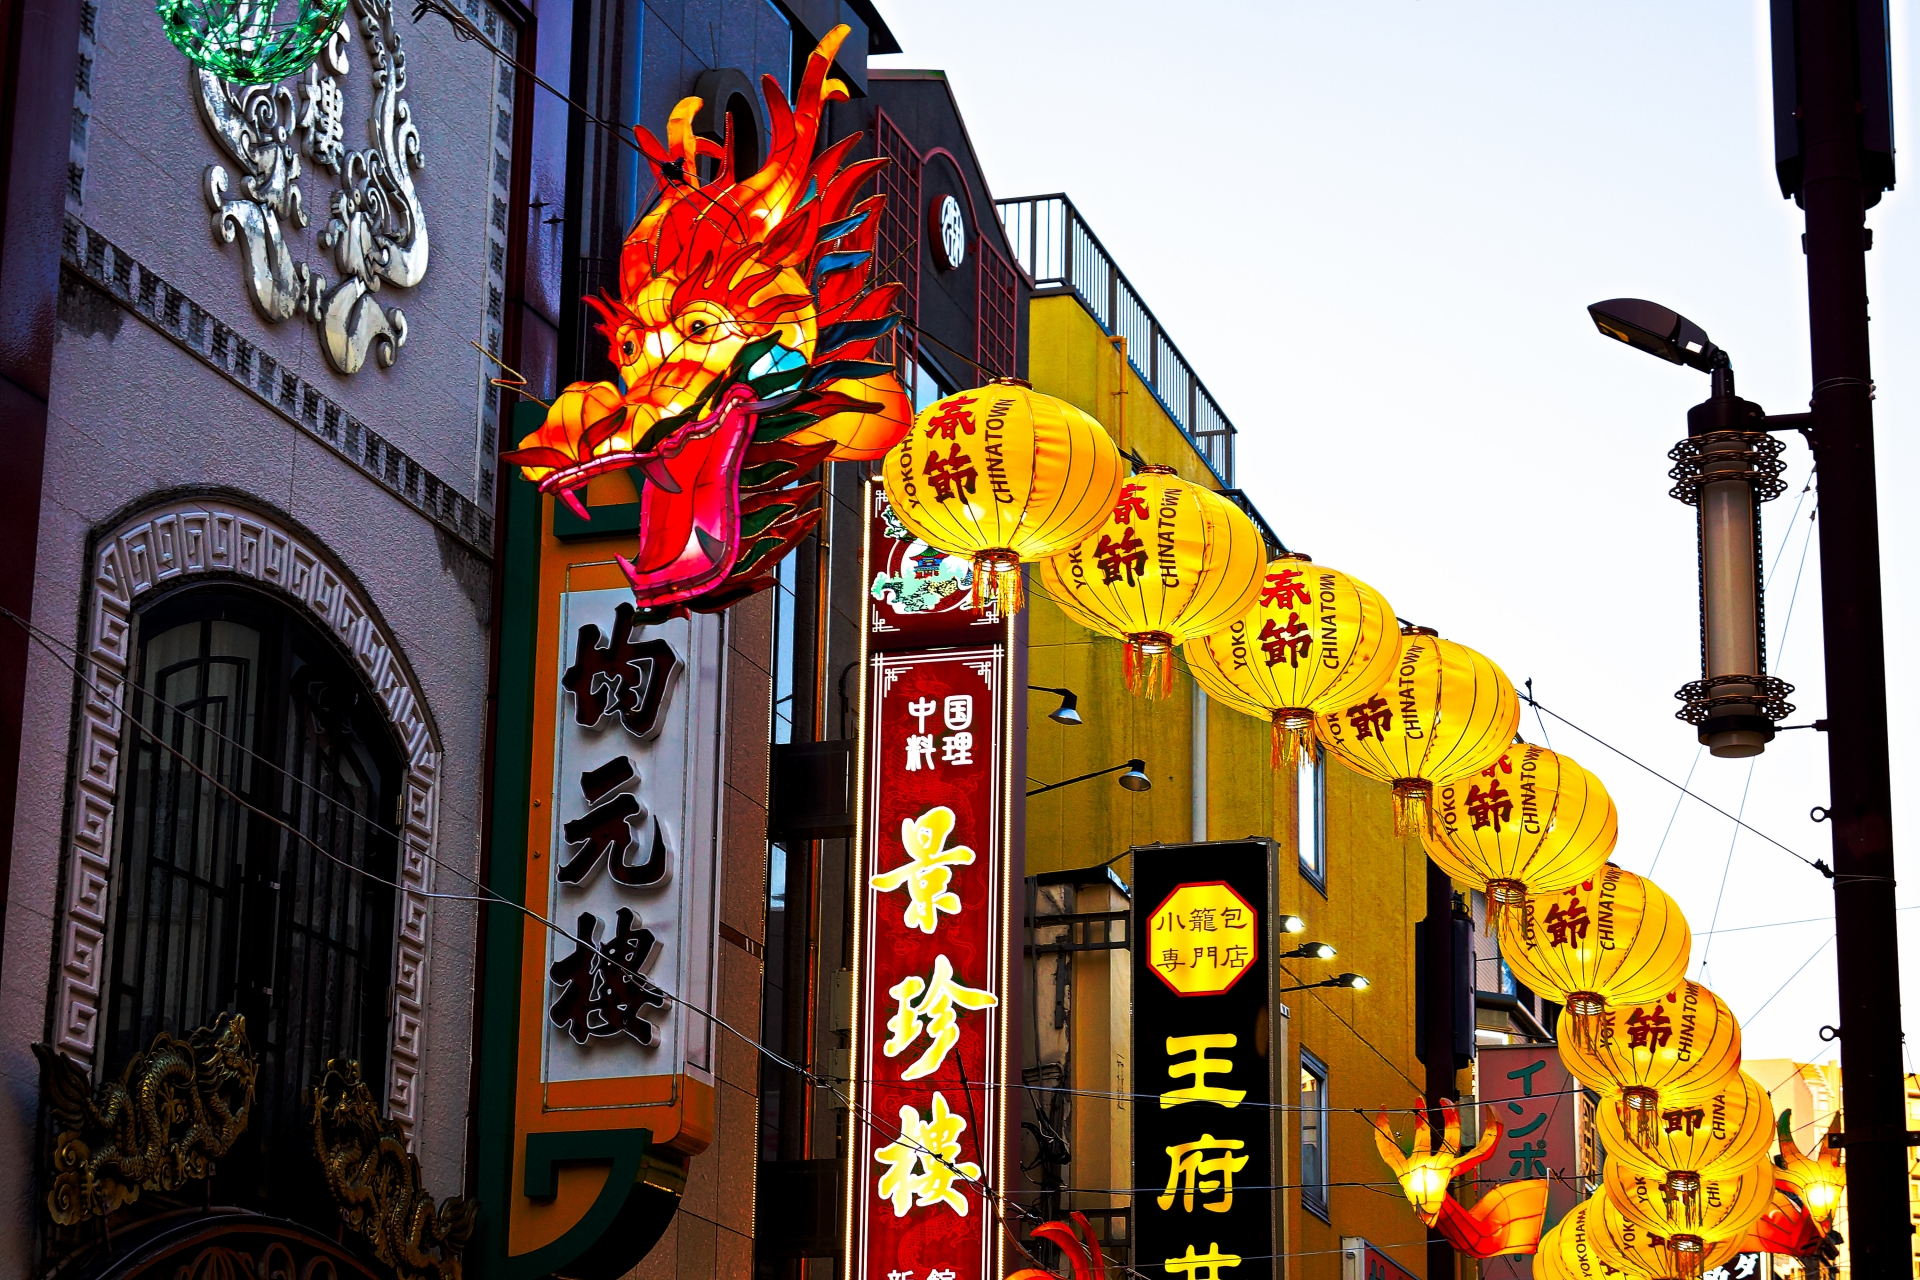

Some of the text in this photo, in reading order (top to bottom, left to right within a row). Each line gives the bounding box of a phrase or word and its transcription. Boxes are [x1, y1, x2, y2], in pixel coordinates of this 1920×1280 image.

[922, 395, 979, 505] 春節
[984, 398, 1016, 505] CHINATOWN
[1092, 483, 1150, 587] 春節
[1158, 488, 1183, 589] CHINATOWN
[1257, 569, 1314, 669] 春節
[1319, 573, 1340, 670] CHINATOWN
[907, 694, 974, 732] 中国
[1398, 645, 1426, 740] CHINATOWN
[905, 733, 974, 771] 料理
[1520, 745, 1544, 835] CHINATOWN
[1156, 907, 1249, 933] 小籠包
[1543, 880, 1594, 950] 節
[1597, 868, 1623, 951] CHINATOWN
[1677, 981, 1700, 1063] CHINATOWN
